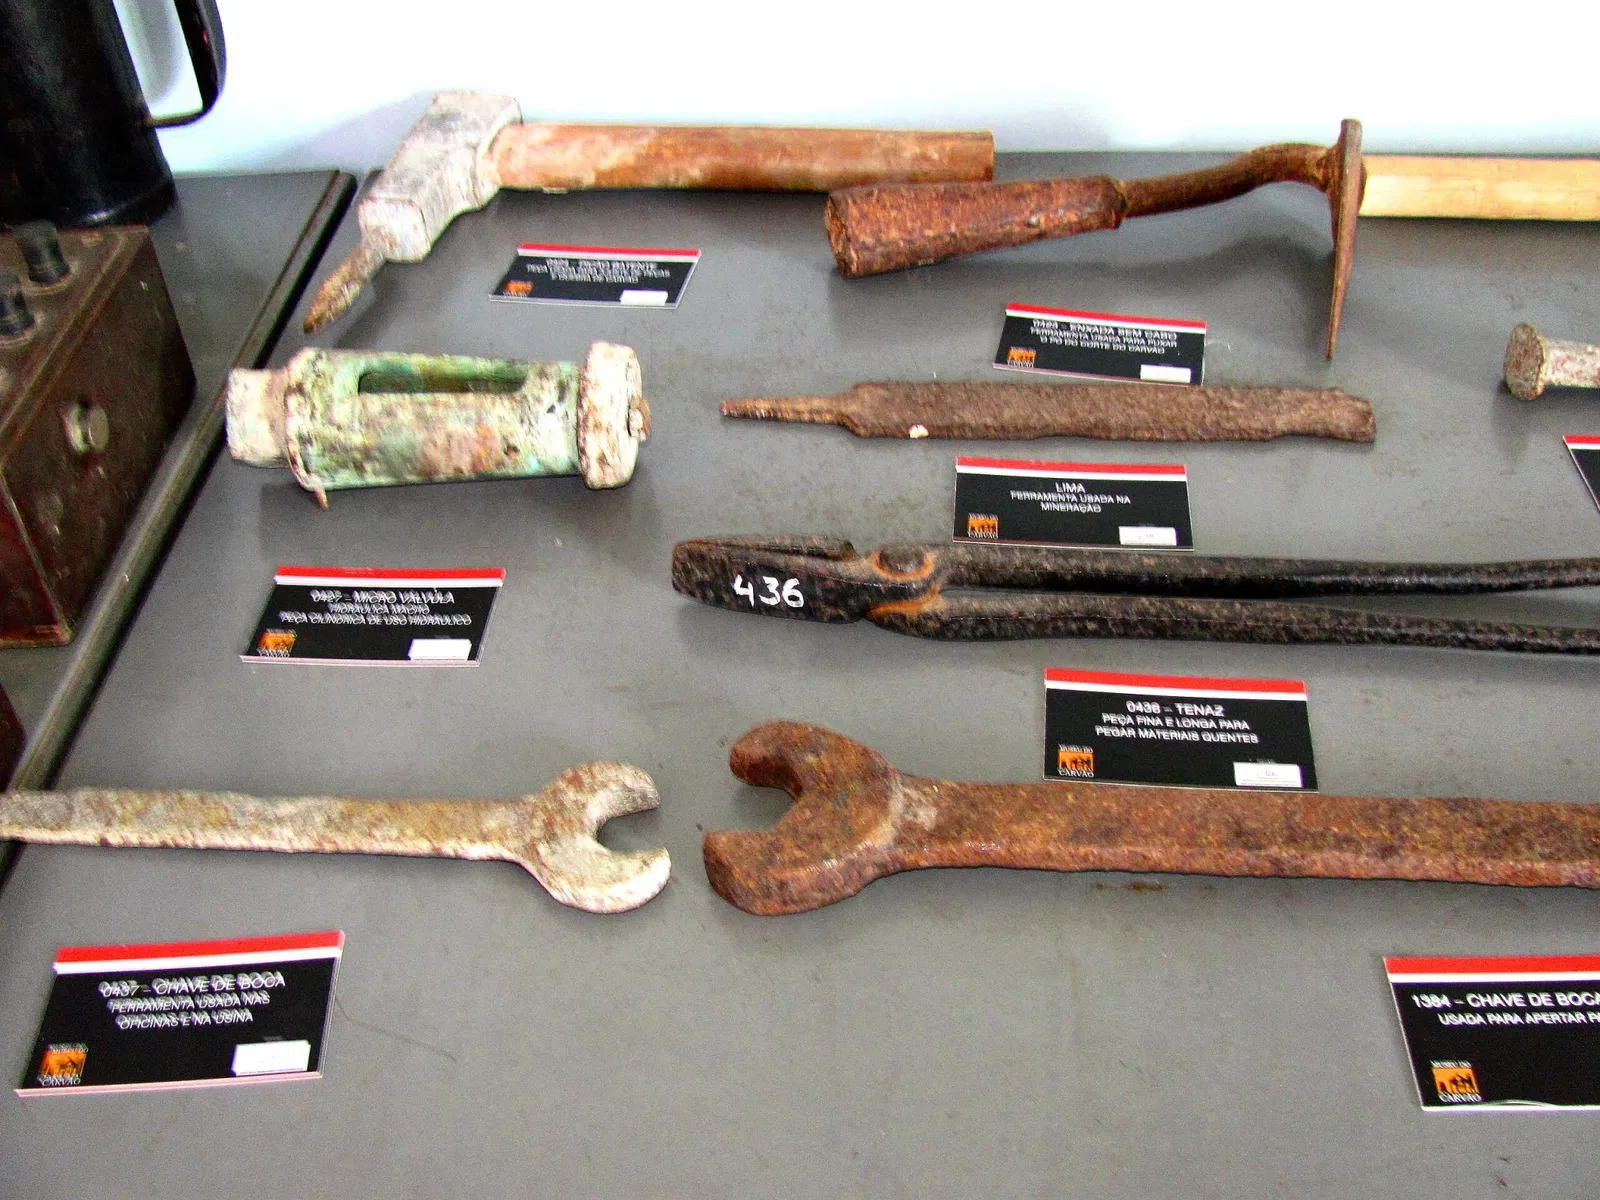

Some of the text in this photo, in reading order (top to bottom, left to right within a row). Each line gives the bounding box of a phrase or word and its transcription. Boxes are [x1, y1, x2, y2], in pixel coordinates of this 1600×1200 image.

[1056, 482, 1085, 493] LIMA
[1010, 490, 1131, 504] FERRAMENTA USADA NA
[352, 590, 397, 604] MICRO
[733, 575, 804, 608] 436
[390, 603, 429, 615] MACHO
[279, 611, 307, 625] PEÇA
[366, 614, 383, 625] DE
[384, 613, 407, 625] USO
[1126, 700, 1160, 714] 0436
[1175, 703, 1224, 717] TENAZ
[1102, 713, 1249, 731] PEÇA FINA E LONGA PARA
[1095, 726, 1259, 744] PEGAR MATERIAIS QUENTES
[99, 981, 140, 998] 0437
[152, 975, 210, 994] CHAVE
[211, 974, 236, 992] DE
[237, 971, 286, 991] BOCA
[107, 990, 270, 1014] FERRAMENTA USADA NAS
[1411, 994, 1451, 1008] 1384
[1465, 993, 1527, 1008] CHAVE
[1528, 992, 1553, 1007] DE
[115, 1009, 254, 1030] OFICINAS E NA USINA
[1438, 1012, 1486, 1025] USADA
[1488, 1012, 1522, 1025] PARA
[1525, 1012, 1585, 1024] APERTAR
